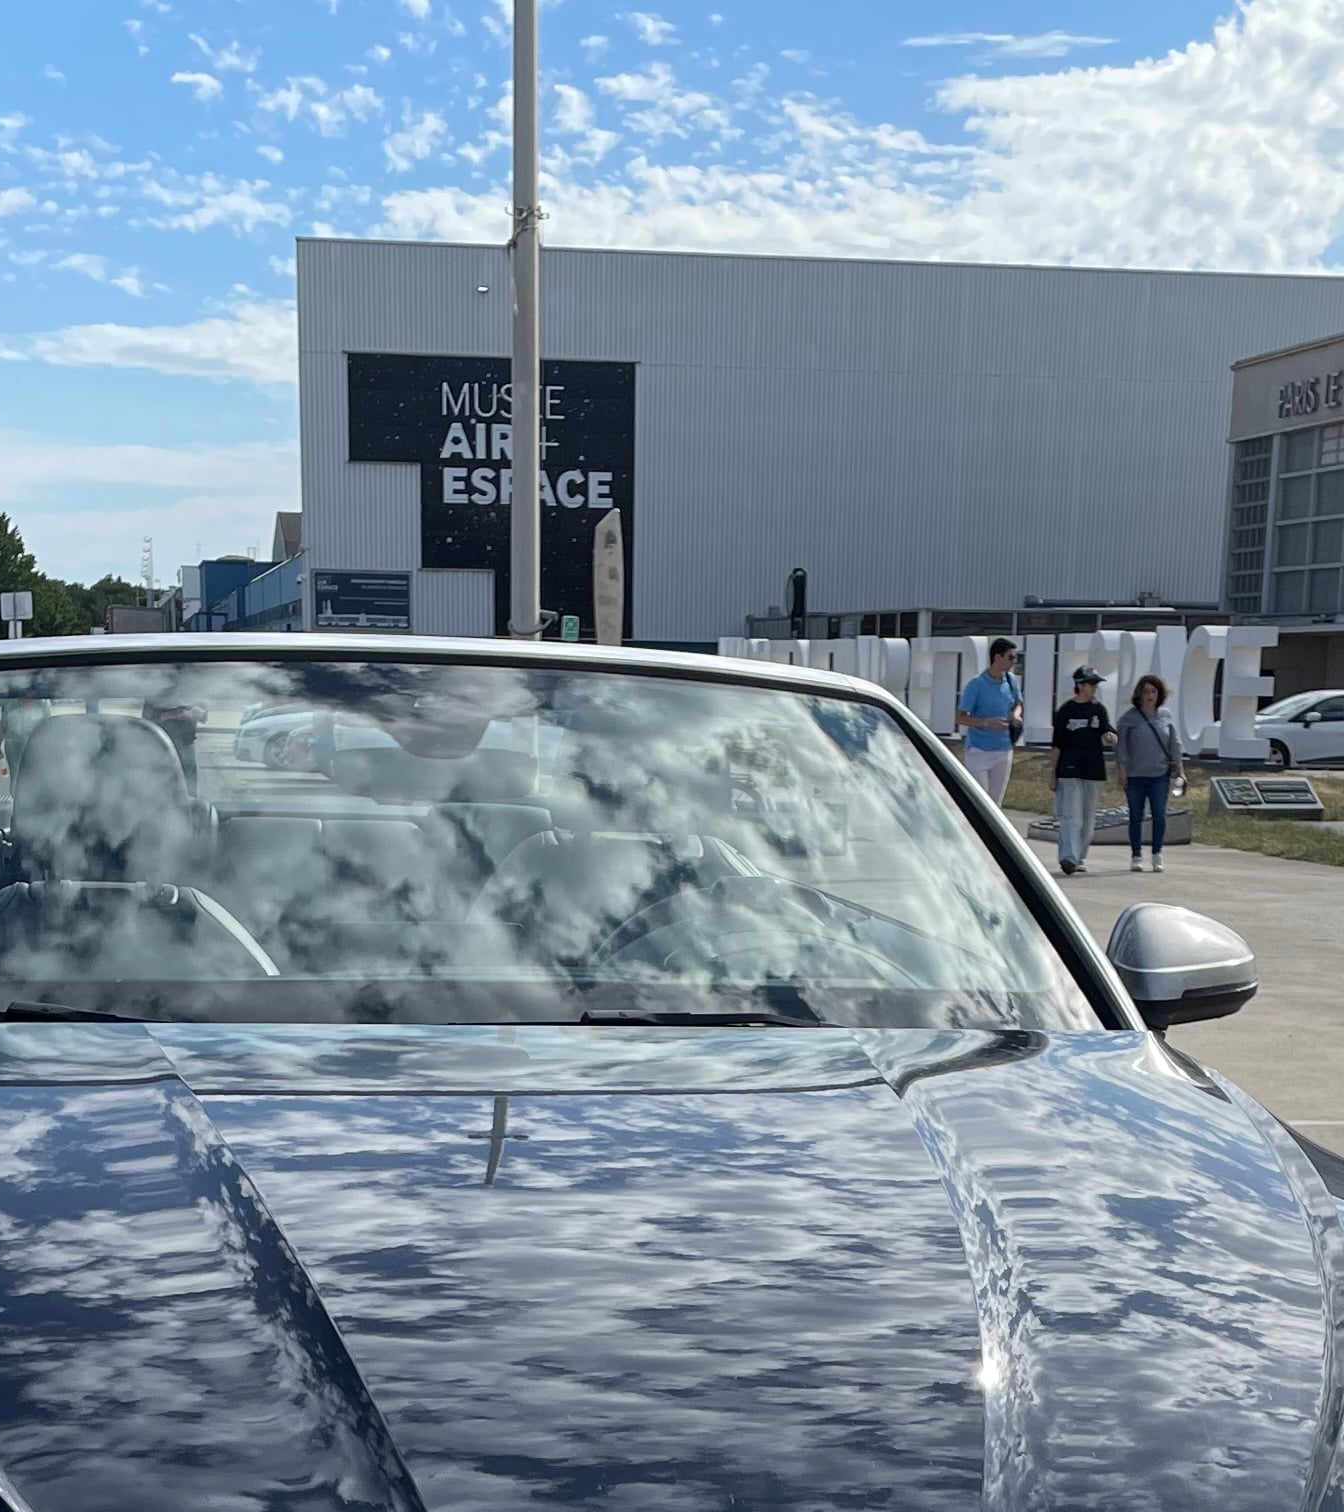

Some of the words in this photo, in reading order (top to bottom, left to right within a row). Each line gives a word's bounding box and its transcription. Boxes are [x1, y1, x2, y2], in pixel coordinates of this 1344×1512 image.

[441, 382, 565, 419] MUSE
[1278, 377, 1320, 418] PARIS
[1324, 371, 1344, 409] LE
[440, 422, 513, 460] AIR
